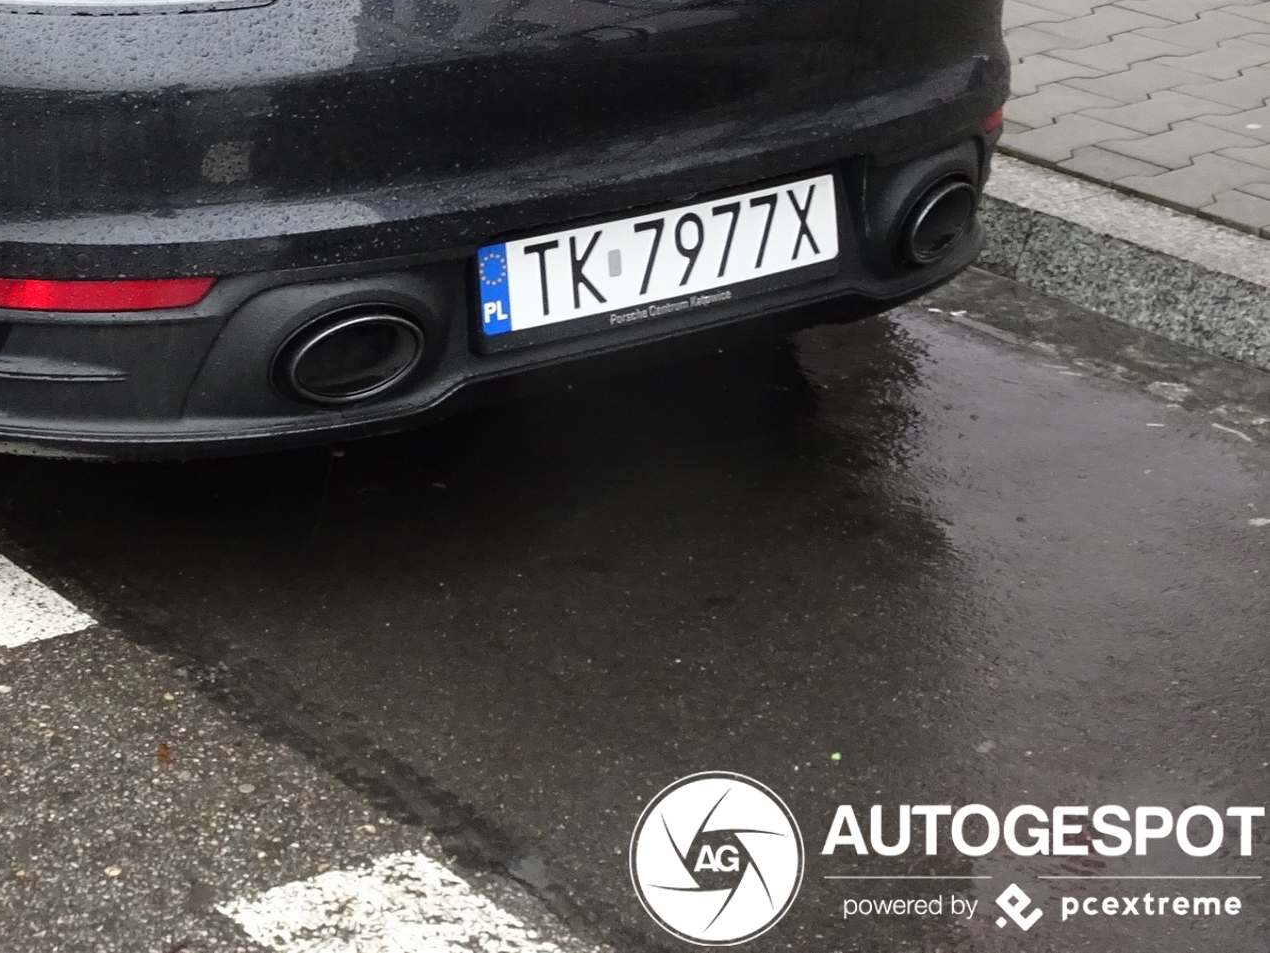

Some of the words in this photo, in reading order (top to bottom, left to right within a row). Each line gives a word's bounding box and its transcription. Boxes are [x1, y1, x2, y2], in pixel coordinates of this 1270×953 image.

[524, 230, 607, 316] TK
[633, 184, 821, 296] 7977X
[484, 302, 508, 323] PL
[610, 308, 648, 325] Porsche
[648, 300, 689, 317] Centrum
[690, 290, 732, 307] Katowice
